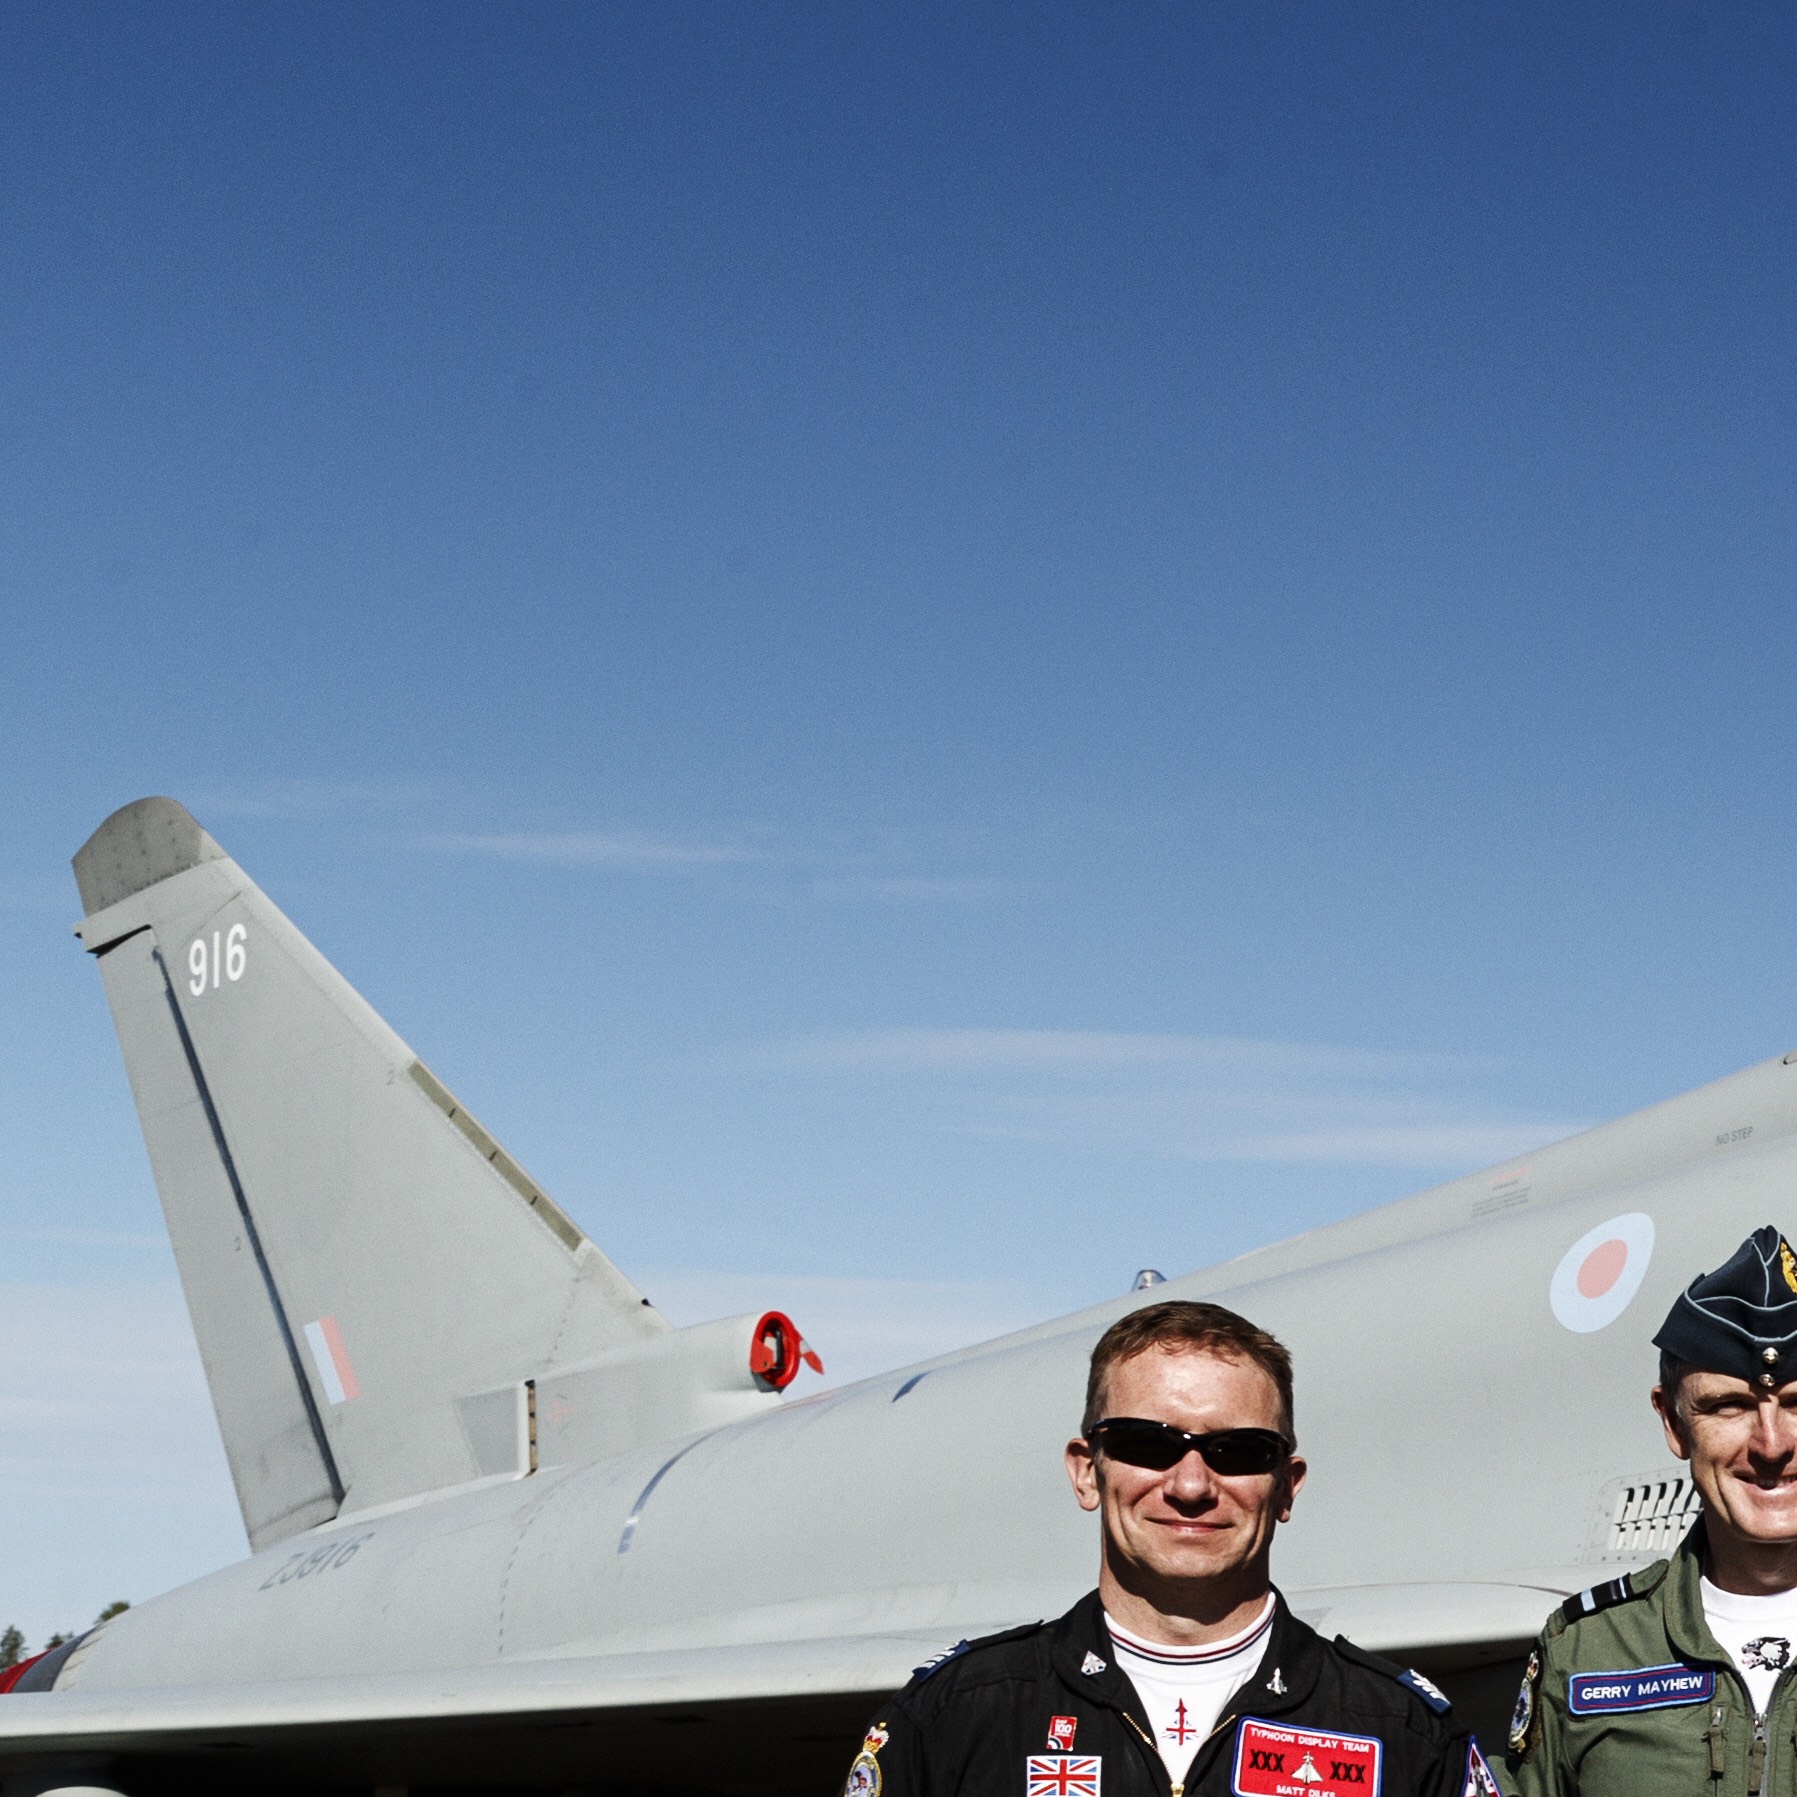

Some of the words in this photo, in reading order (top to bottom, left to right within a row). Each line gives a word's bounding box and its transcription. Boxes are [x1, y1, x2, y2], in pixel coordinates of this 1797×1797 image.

[188, 923, 247, 997] 916
[1581, 1685, 1632, 1700] GERRY
[1638, 1676, 1703, 1696] MAYHEW
[1250, 1727, 1295, 1743] TYPHOON
[1298, 1735, 1338, 1749] DISPLAY
[1342, 1741, 1370, 1753] TEAM
[1249, 1749, 1285, 1773] XXX
[1329, 1760, 1365, 1783] XXX
[1276, 1784, 1306, 1797] MATT
